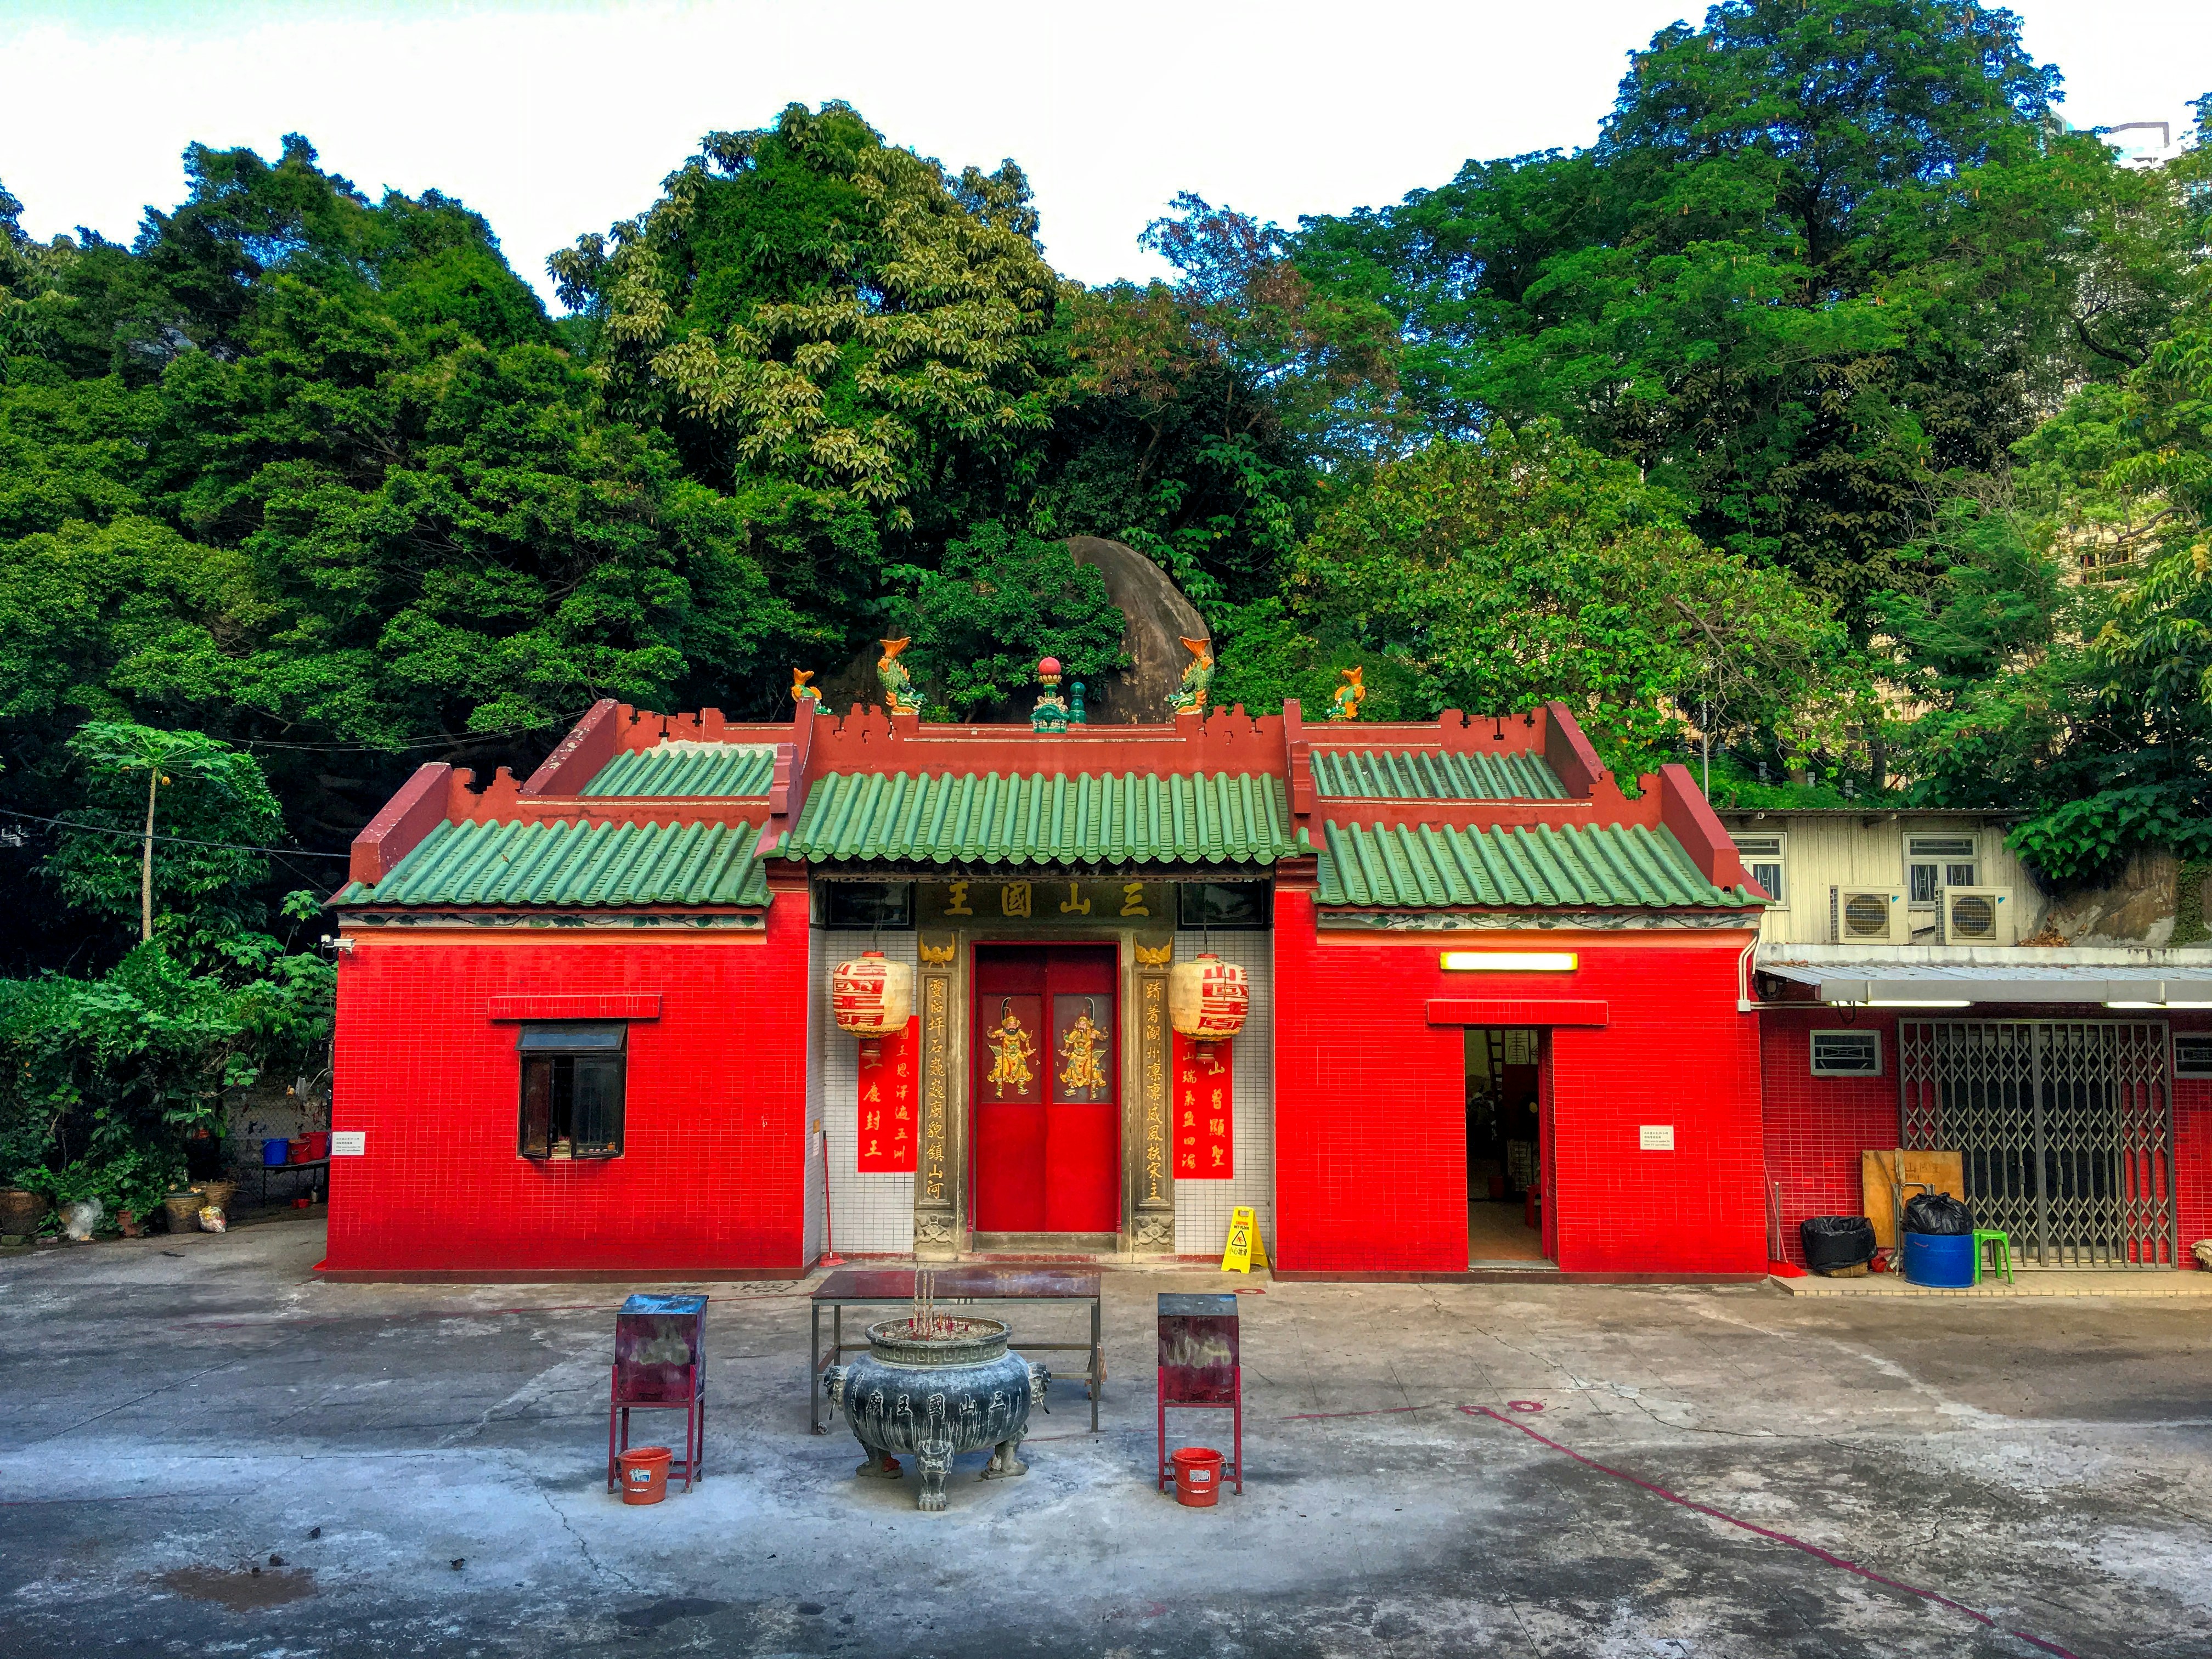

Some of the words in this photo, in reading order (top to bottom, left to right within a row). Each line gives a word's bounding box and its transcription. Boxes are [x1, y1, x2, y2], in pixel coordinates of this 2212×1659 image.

[944, 882, 1150, 918] 三山國王
[1182, 1041, 1197, 1169] 山瑞氣盈四海
[1209, 1042, 1226, 1167] 山曾顯聖
[867, 1389, 1006, 1419] 三山國王廟
